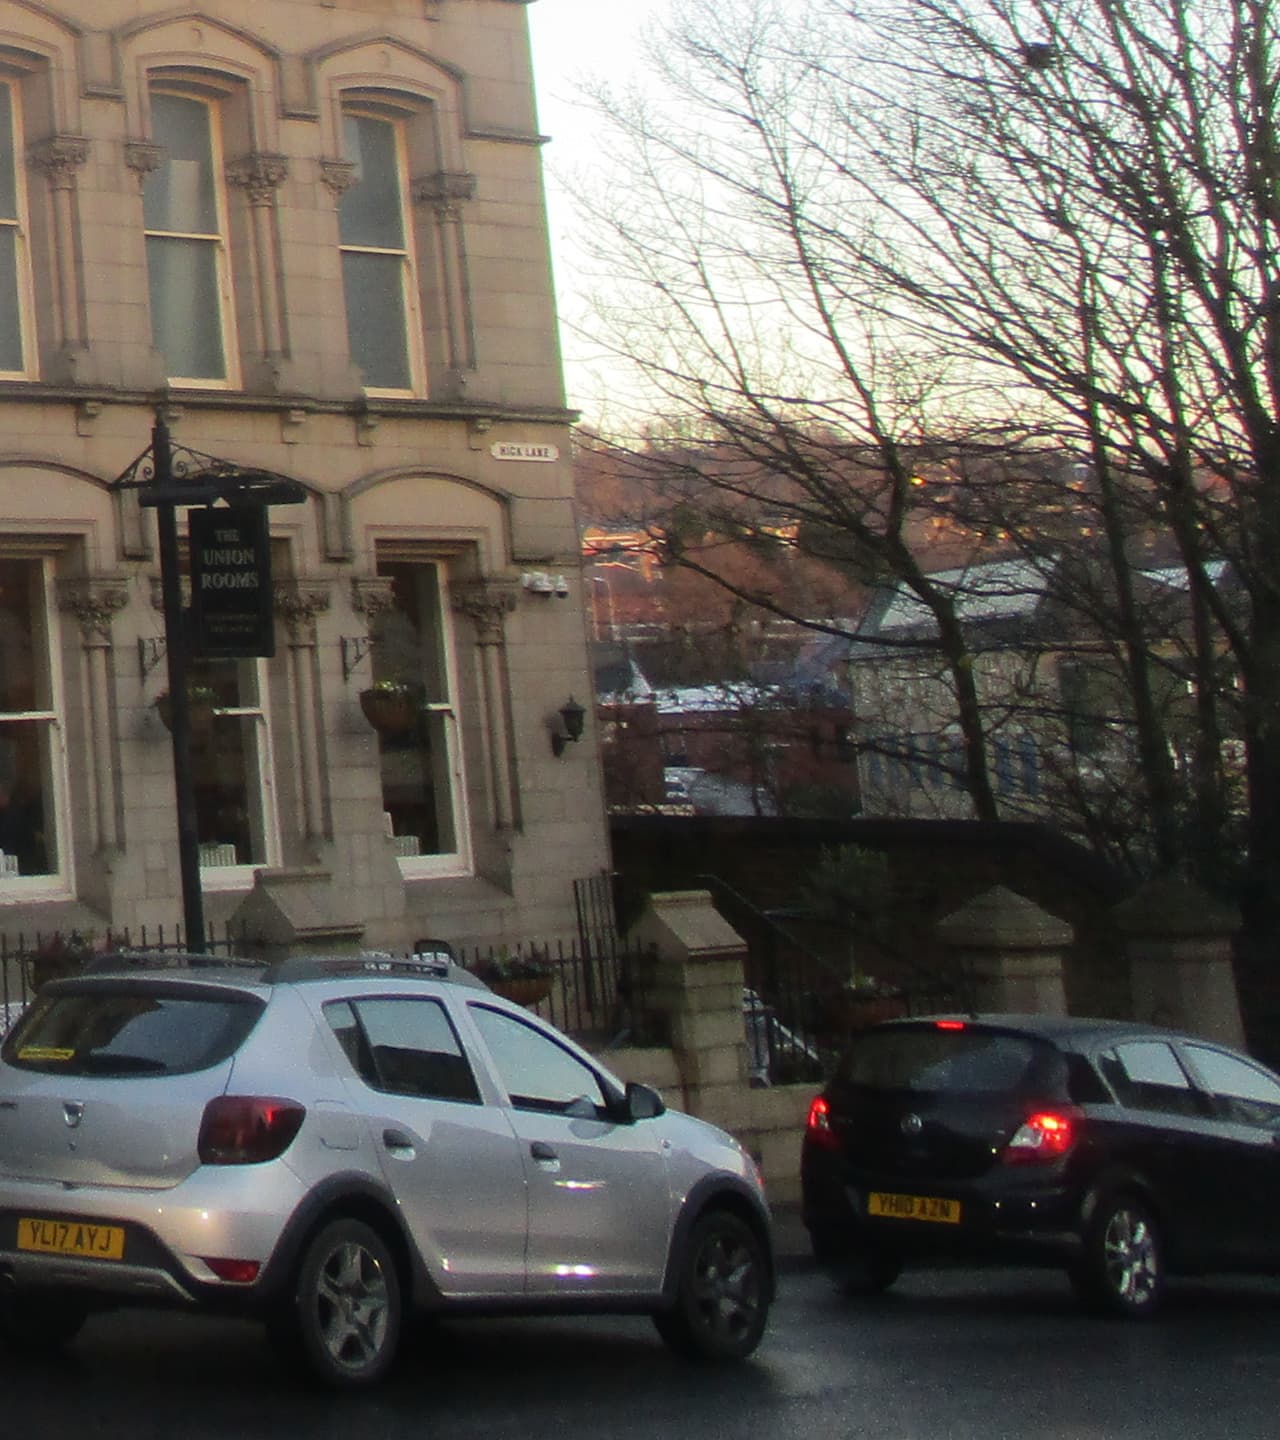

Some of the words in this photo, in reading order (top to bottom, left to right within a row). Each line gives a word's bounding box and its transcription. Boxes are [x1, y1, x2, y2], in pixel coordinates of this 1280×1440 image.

[525, 447, 550, 458] LANE
[214, 529, 240, 542] THE
[203, 548, 255, 566] UNION
[200, 571, 259, 590] ROOMS
[30, 1221, 68, 1249] YL17
[73, 1225, 112, 1252] AYJ
